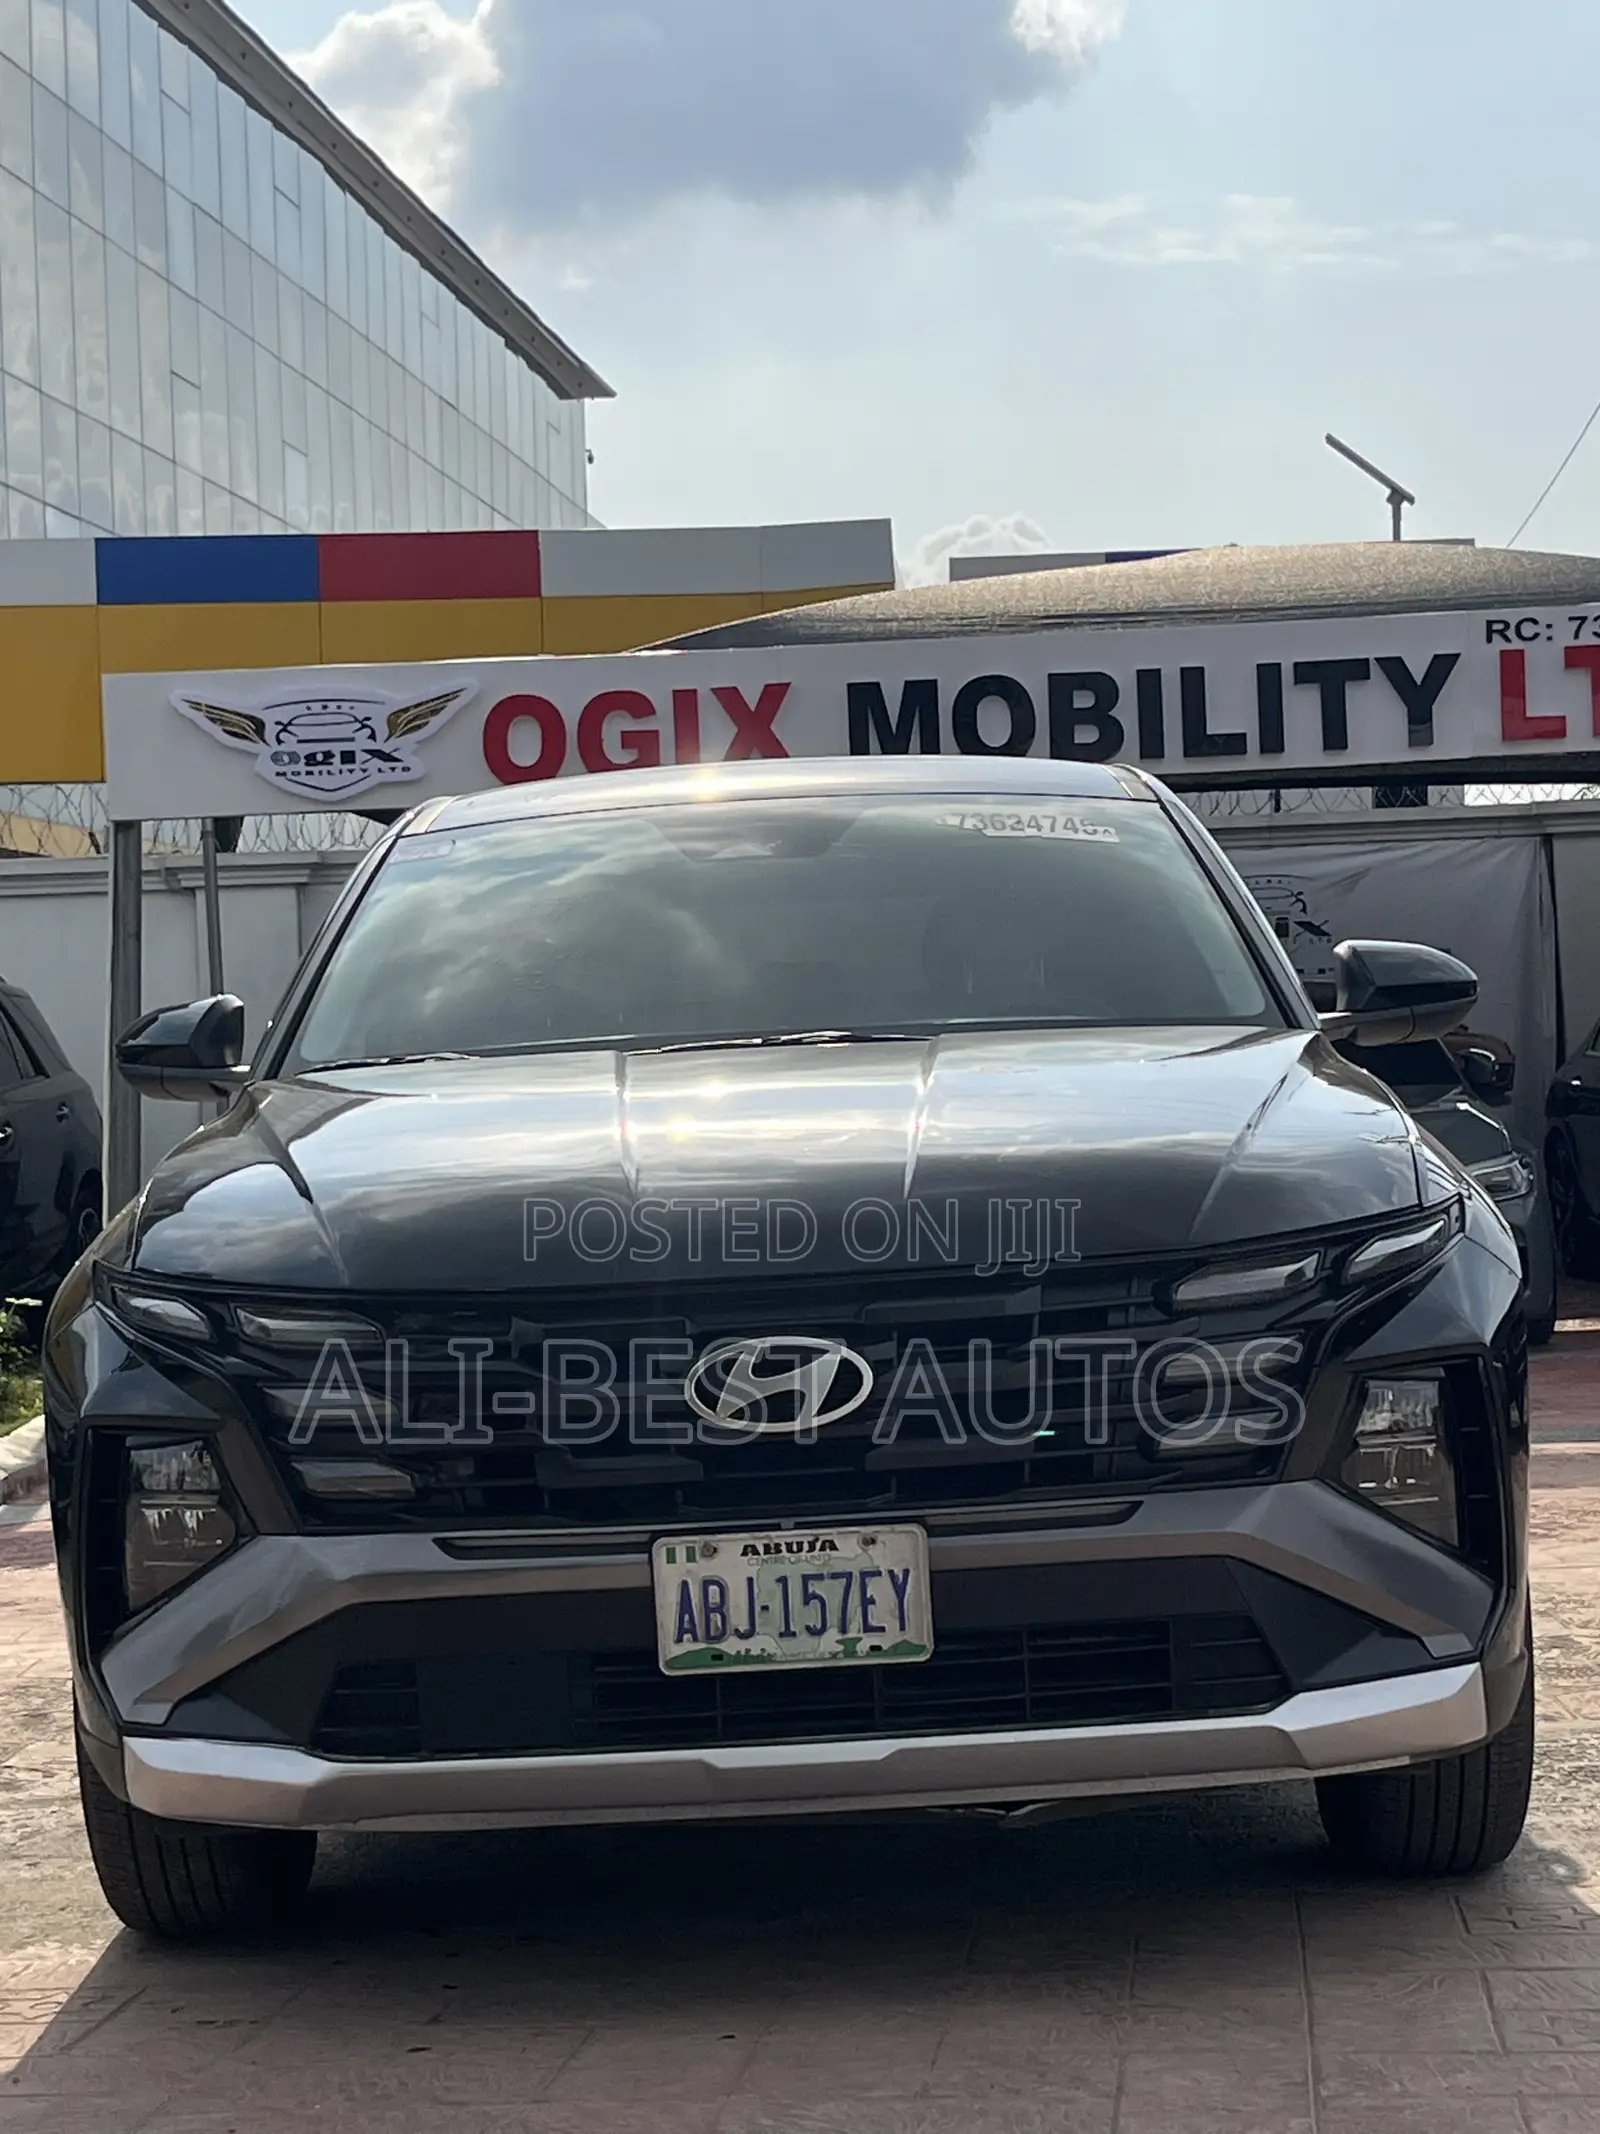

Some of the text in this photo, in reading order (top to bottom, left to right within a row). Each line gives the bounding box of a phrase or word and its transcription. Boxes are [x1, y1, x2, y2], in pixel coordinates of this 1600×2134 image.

[1485, 617, 1553, 644] RC:
[482, 681, 793, 786] OGIX
[846, 652, 1462, 762] MOBILITY
[740, 1537, 840, 1558] ABUJA
[674, 1567, 911, 1644] ABJ-157EY
